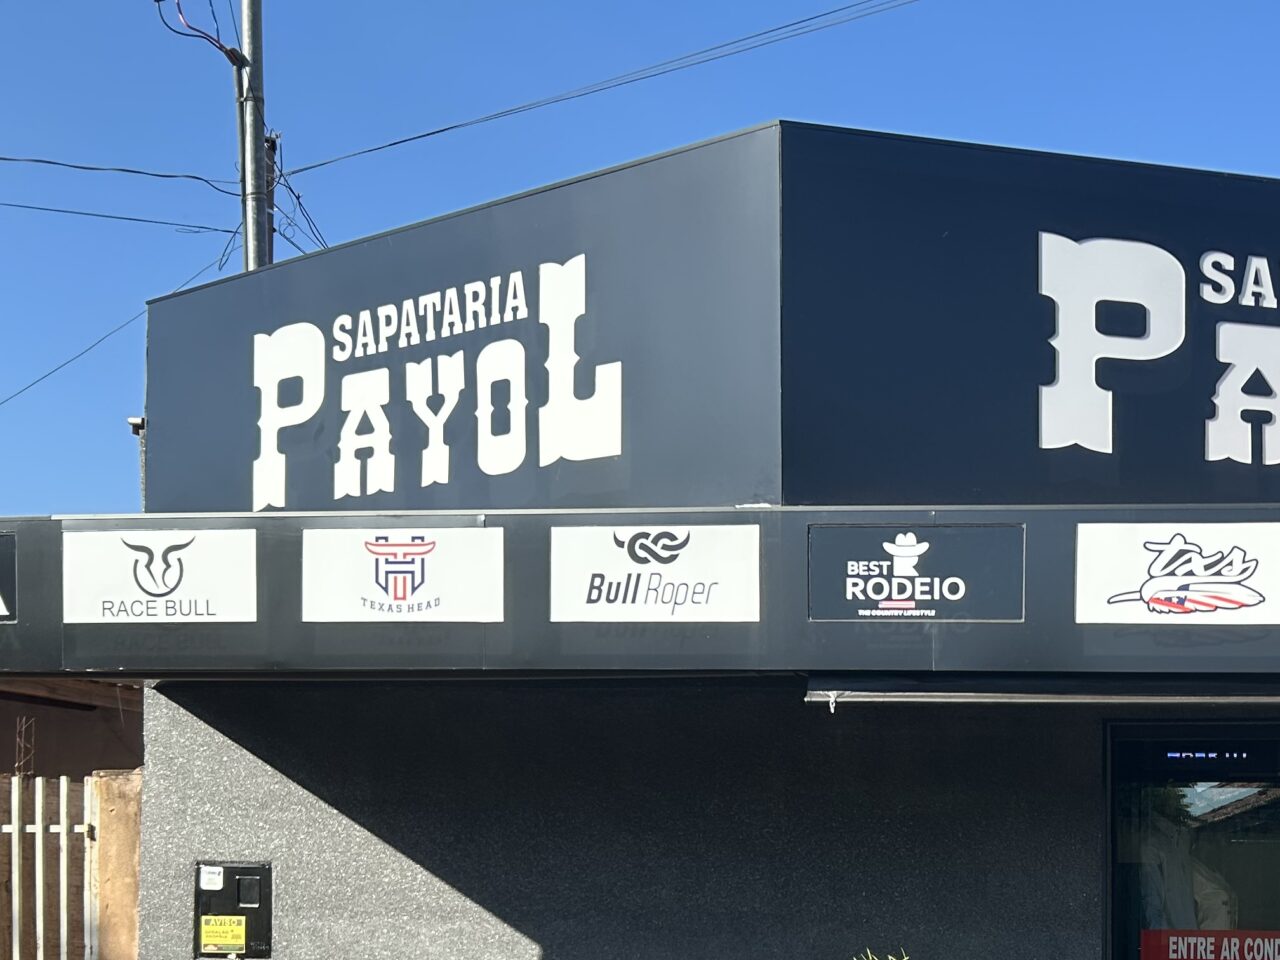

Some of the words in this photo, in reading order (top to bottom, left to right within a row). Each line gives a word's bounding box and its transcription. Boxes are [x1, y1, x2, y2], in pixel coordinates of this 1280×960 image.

[332, 270, 528, 362] SAPATARIA
[252, 253, 622, 513] PAYOL
[847, 560, 892, 576] BEST
[586, 572, 642, 605] Bull
[644, 572, 719, 616] Roper
[845, 576, 966, 601] RODEIO
[102, 600, 158, 617] RACE
[164, 599, 217, 616] BULL
[360, 596, 403, 613] TEXAS
[407, 596, 441, 613] HEAD
[1168, 936, 1215, 960] ENTRE
[1220, 937, 1240, 960] AR
